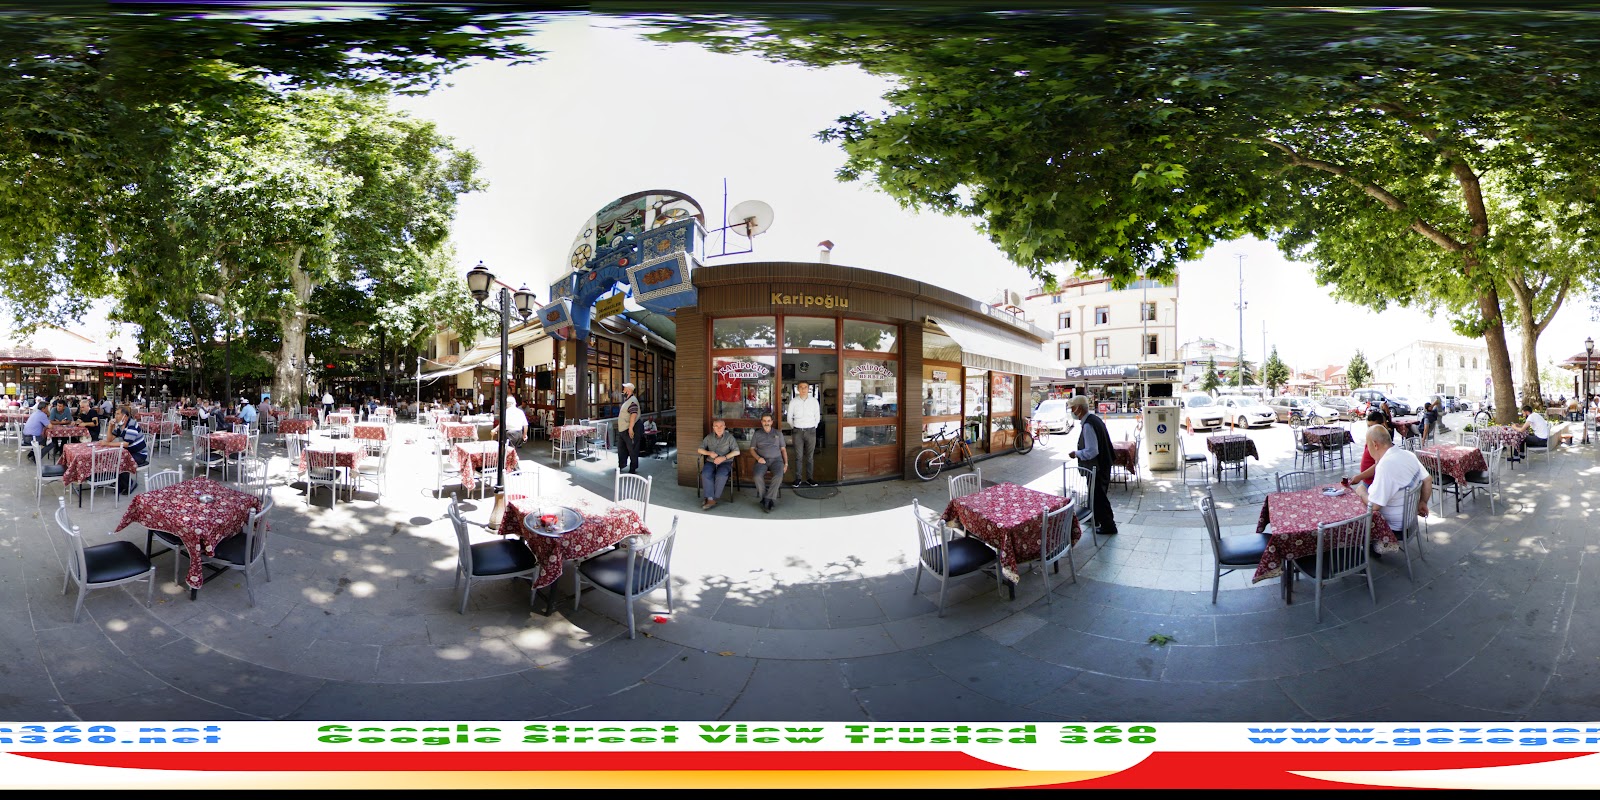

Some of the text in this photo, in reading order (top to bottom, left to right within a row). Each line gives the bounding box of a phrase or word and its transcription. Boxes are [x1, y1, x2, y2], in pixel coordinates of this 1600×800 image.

[771, 292, 849, 309] Karipoğlu
[718, 360, 770, 376] KARİPOĞLU
[849, 362, 894, 378] KARİPOĞLU
[1083, 366, 1125, 376] KURUYEMİŞ
